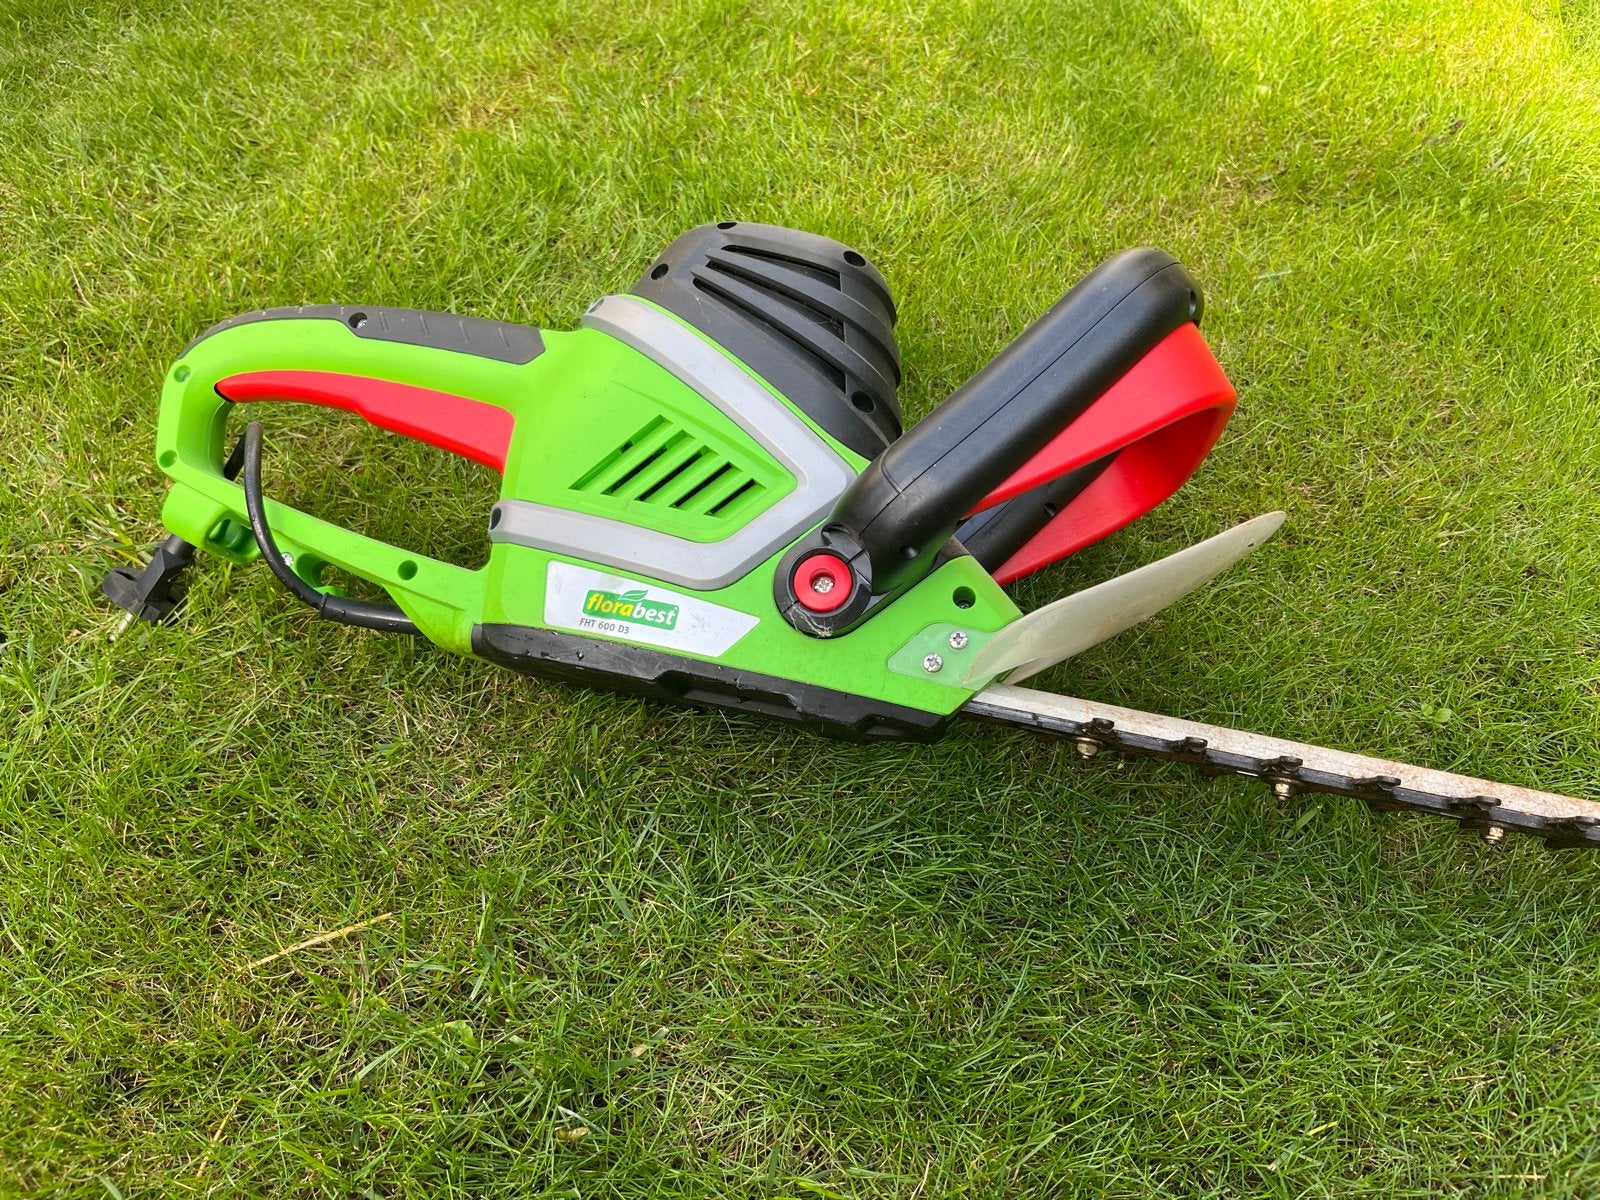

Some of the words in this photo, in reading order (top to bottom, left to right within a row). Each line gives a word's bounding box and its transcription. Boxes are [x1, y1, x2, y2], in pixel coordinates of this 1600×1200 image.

[587, 593, 676, 625] florabest
[580, 618, 597, 628] FHT
[598, 621, 615, 631] 600
[618, 625, 630, 634] D3
